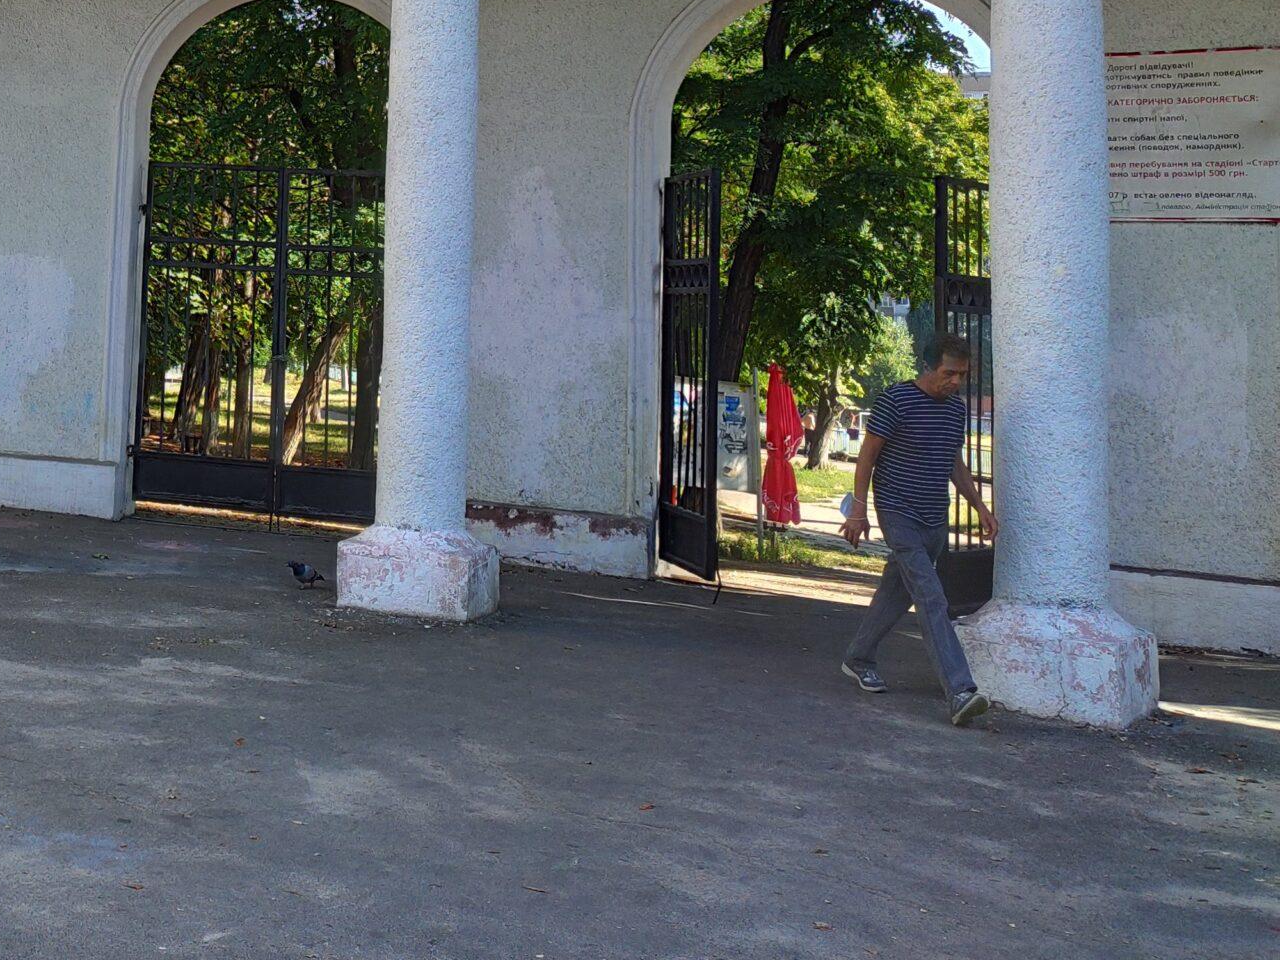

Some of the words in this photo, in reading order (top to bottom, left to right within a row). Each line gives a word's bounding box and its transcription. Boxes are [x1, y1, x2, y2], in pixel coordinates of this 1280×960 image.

[1107, 64, 1137, 73] Дорогі
[1177, 71, 1211, 79] правил
[1107, 98, 1174, 106] КАТЕГОРИЧНО
[1130, 134, 1157, 142] собак
[1158, 133, 1175, 141] без
[1131, 170, 1161, 179] штраф
[1208, 169, 1226, 177] 500
